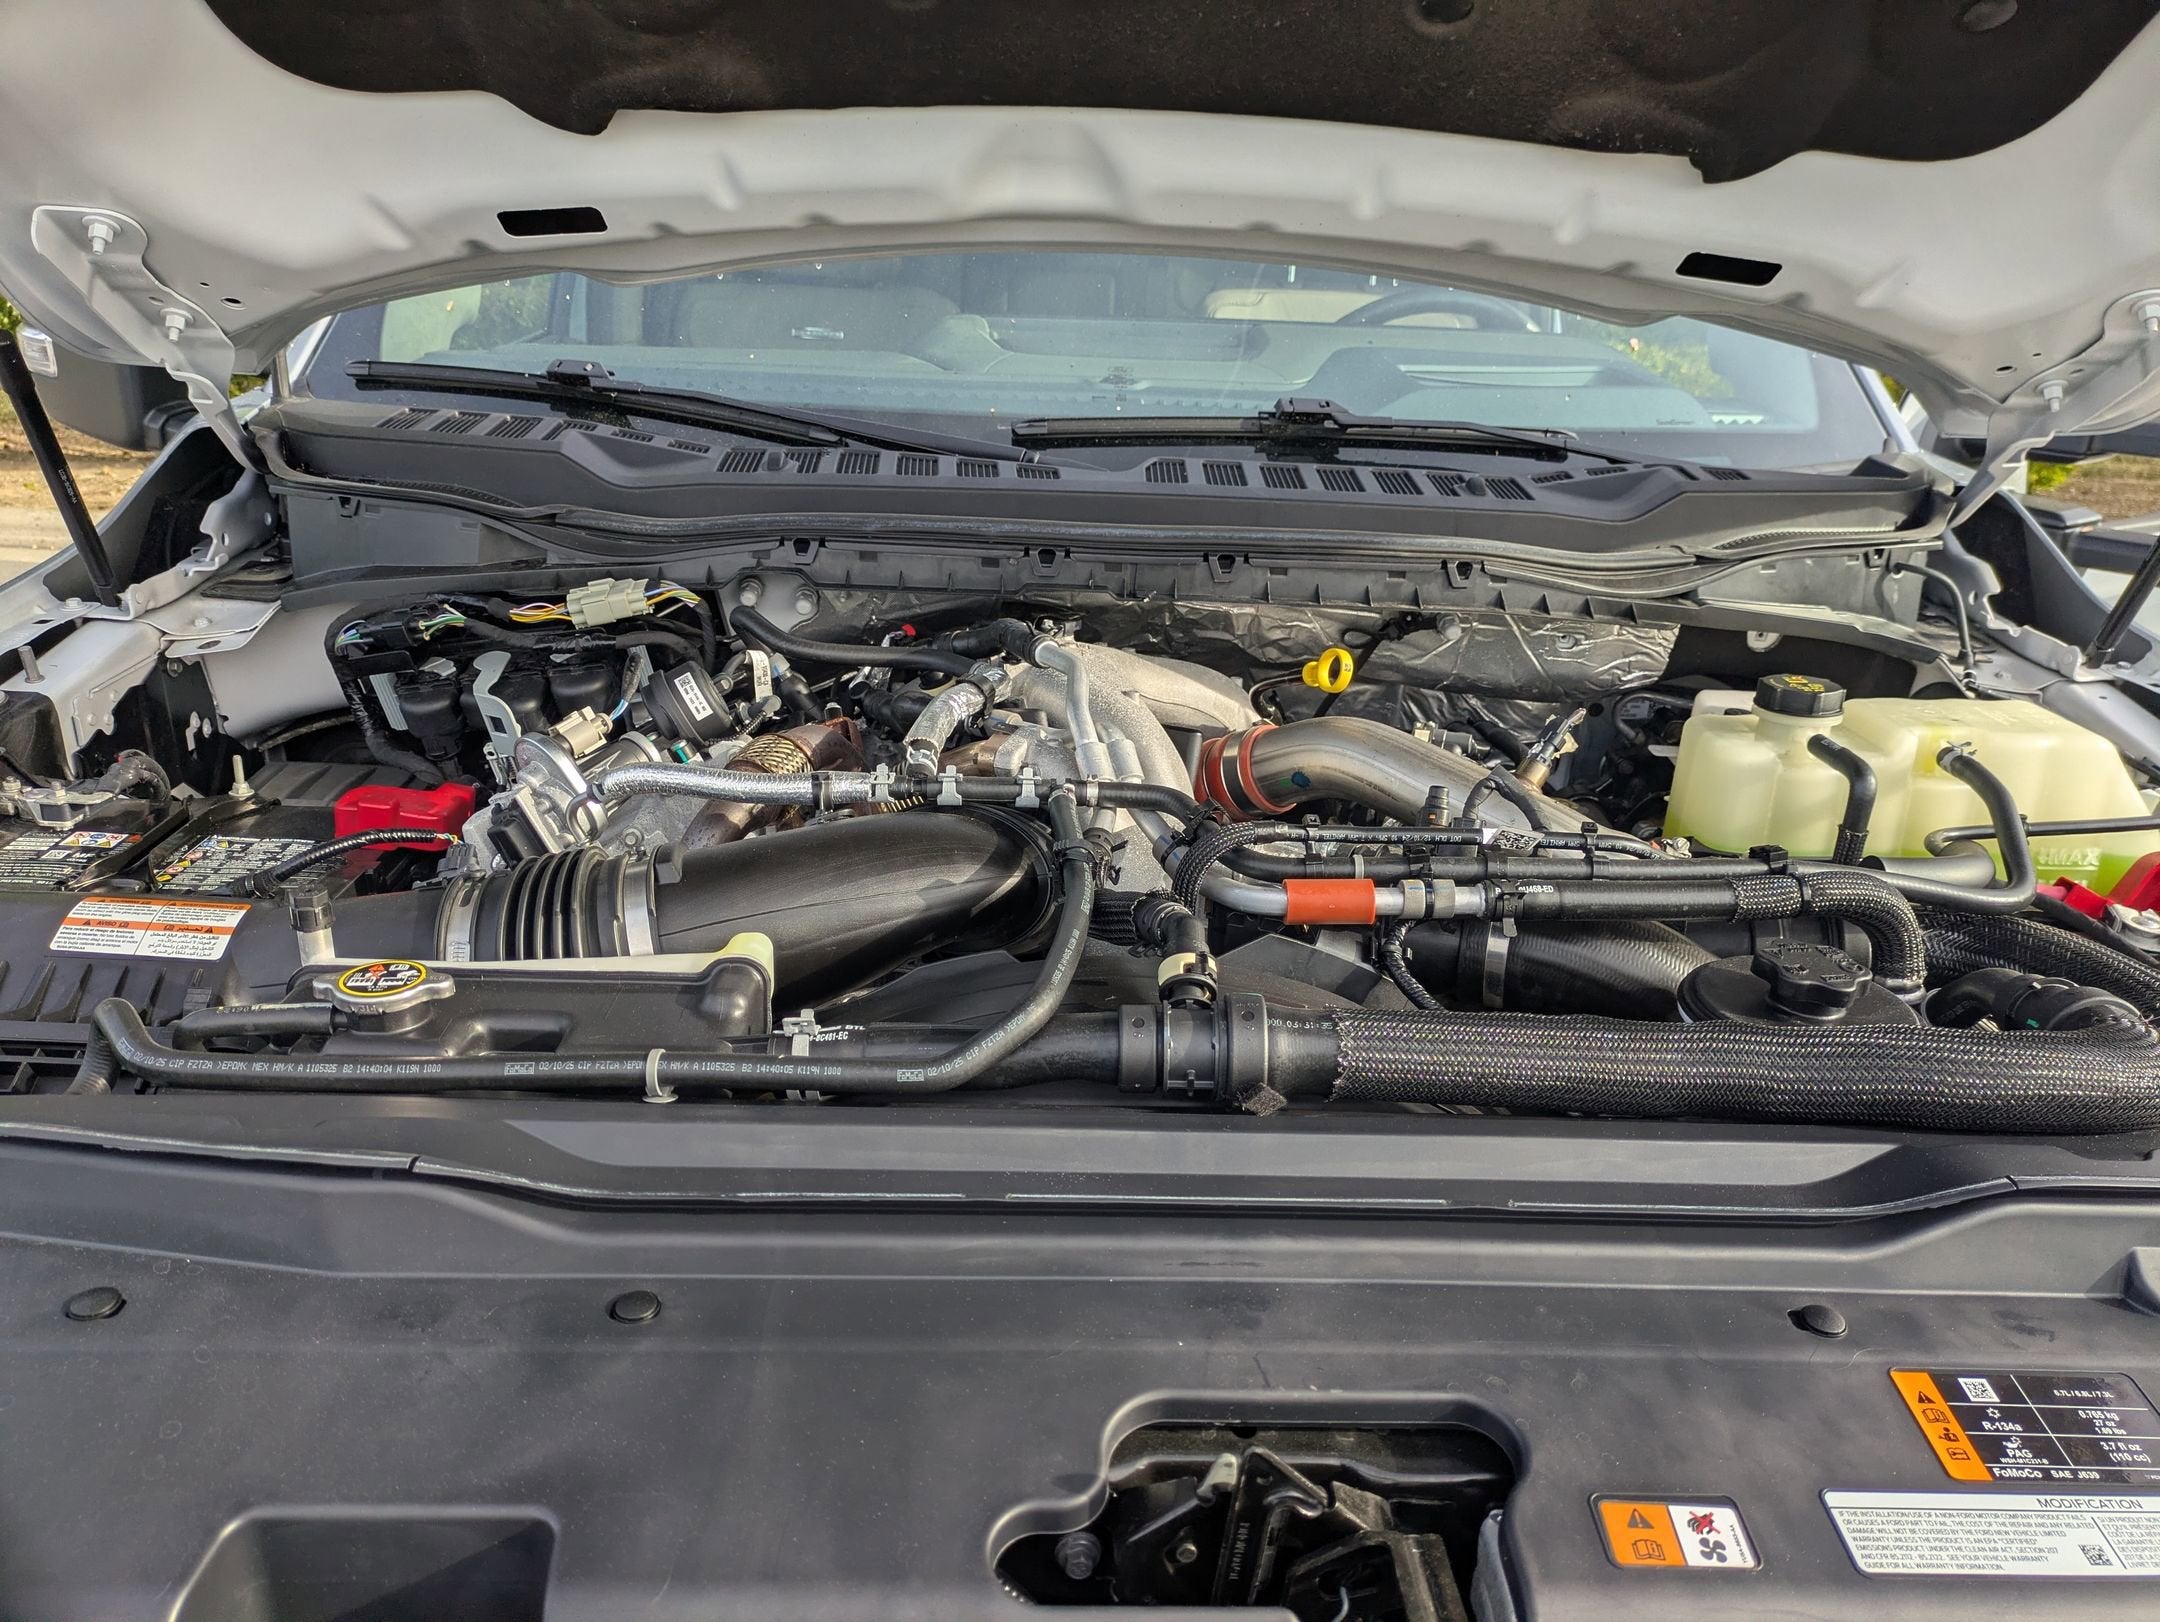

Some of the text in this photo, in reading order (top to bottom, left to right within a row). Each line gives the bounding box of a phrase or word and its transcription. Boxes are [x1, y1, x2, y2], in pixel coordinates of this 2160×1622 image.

[133, 1051, 167, 1068] 02/10/25
[356, 1064, 393, 1074] 14:40:04
[423, 1063, 442, 1073] 1000
[538, 1061, 575, 1071] 02/10/25
[756, 1063, 794, 1074] 14:40:05
[2105, 1411, 2120, 1421] kg
[1982, 1421, 2023, 1432] R-134a
[2100, 1441, 2117, 1451] 3.7
[2006, 1448, 2033, 1459] PAG
[2132, 1453, 2152, 1464] cc)
[1992, 1468, 2043, 1478] FoMoCo
[2050, 1470, 2074, 1479] SAE
[2035, 1498, 2144, 1510] MODIFICATION
